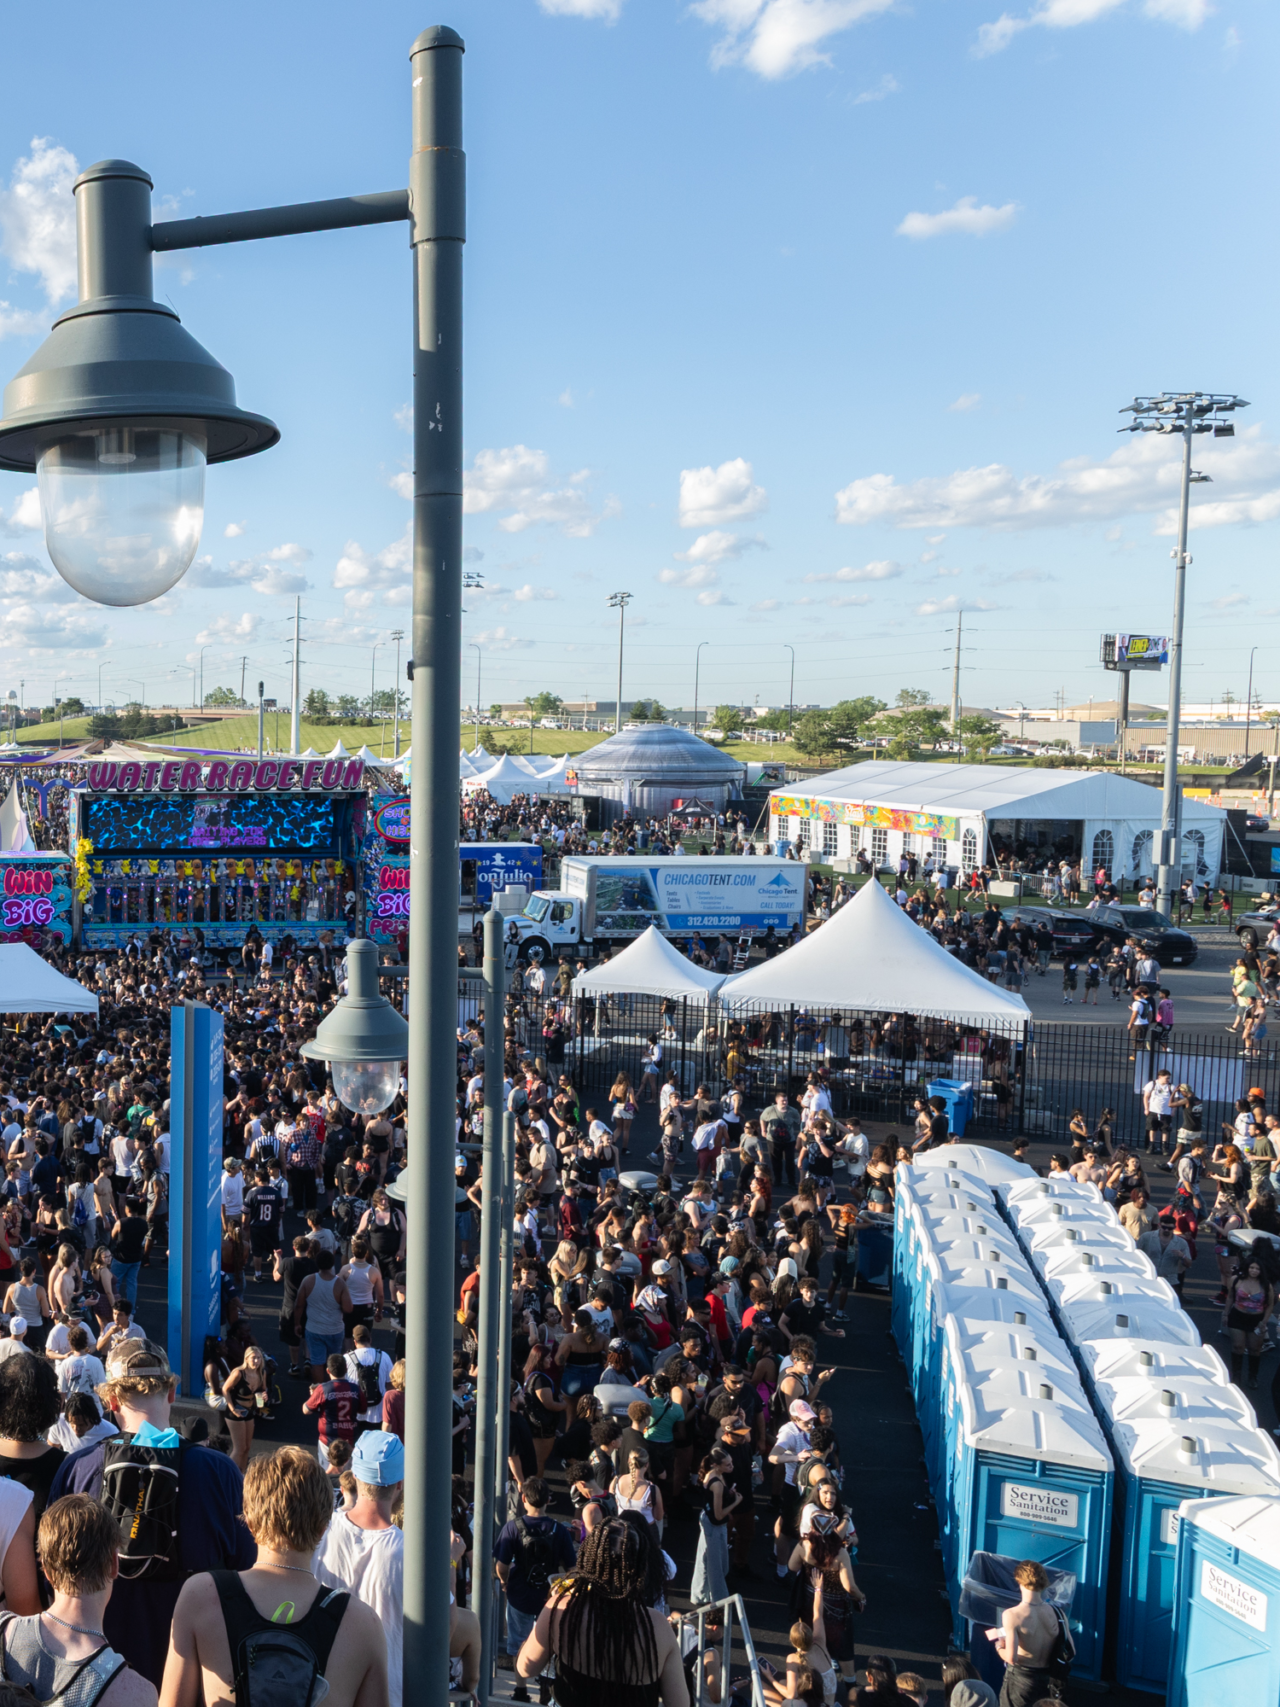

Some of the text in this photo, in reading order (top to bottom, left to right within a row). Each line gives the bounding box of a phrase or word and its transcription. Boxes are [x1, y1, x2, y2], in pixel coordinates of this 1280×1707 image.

[87, 759, 365, 792] WATER RACE FUN
[193, 827, 264, 837] WAITING FOR
[221, 837, 267, 846] PLAYERS
[664, 873, 756, 886] CHICAGOTENT.COM
[687, 915, 741, 926] 312.420.2200
[259, 1204, 272, 1221] 18
[338, 1401, 350, 1420] 2
[1010, 1486, 1069, 1507] Service
[1009, 1498, 1068, 1516] Sanitation
[1209, 1567, 1258, 1606] Service
[1208, 1580, 1257, 1616] Sanitation
